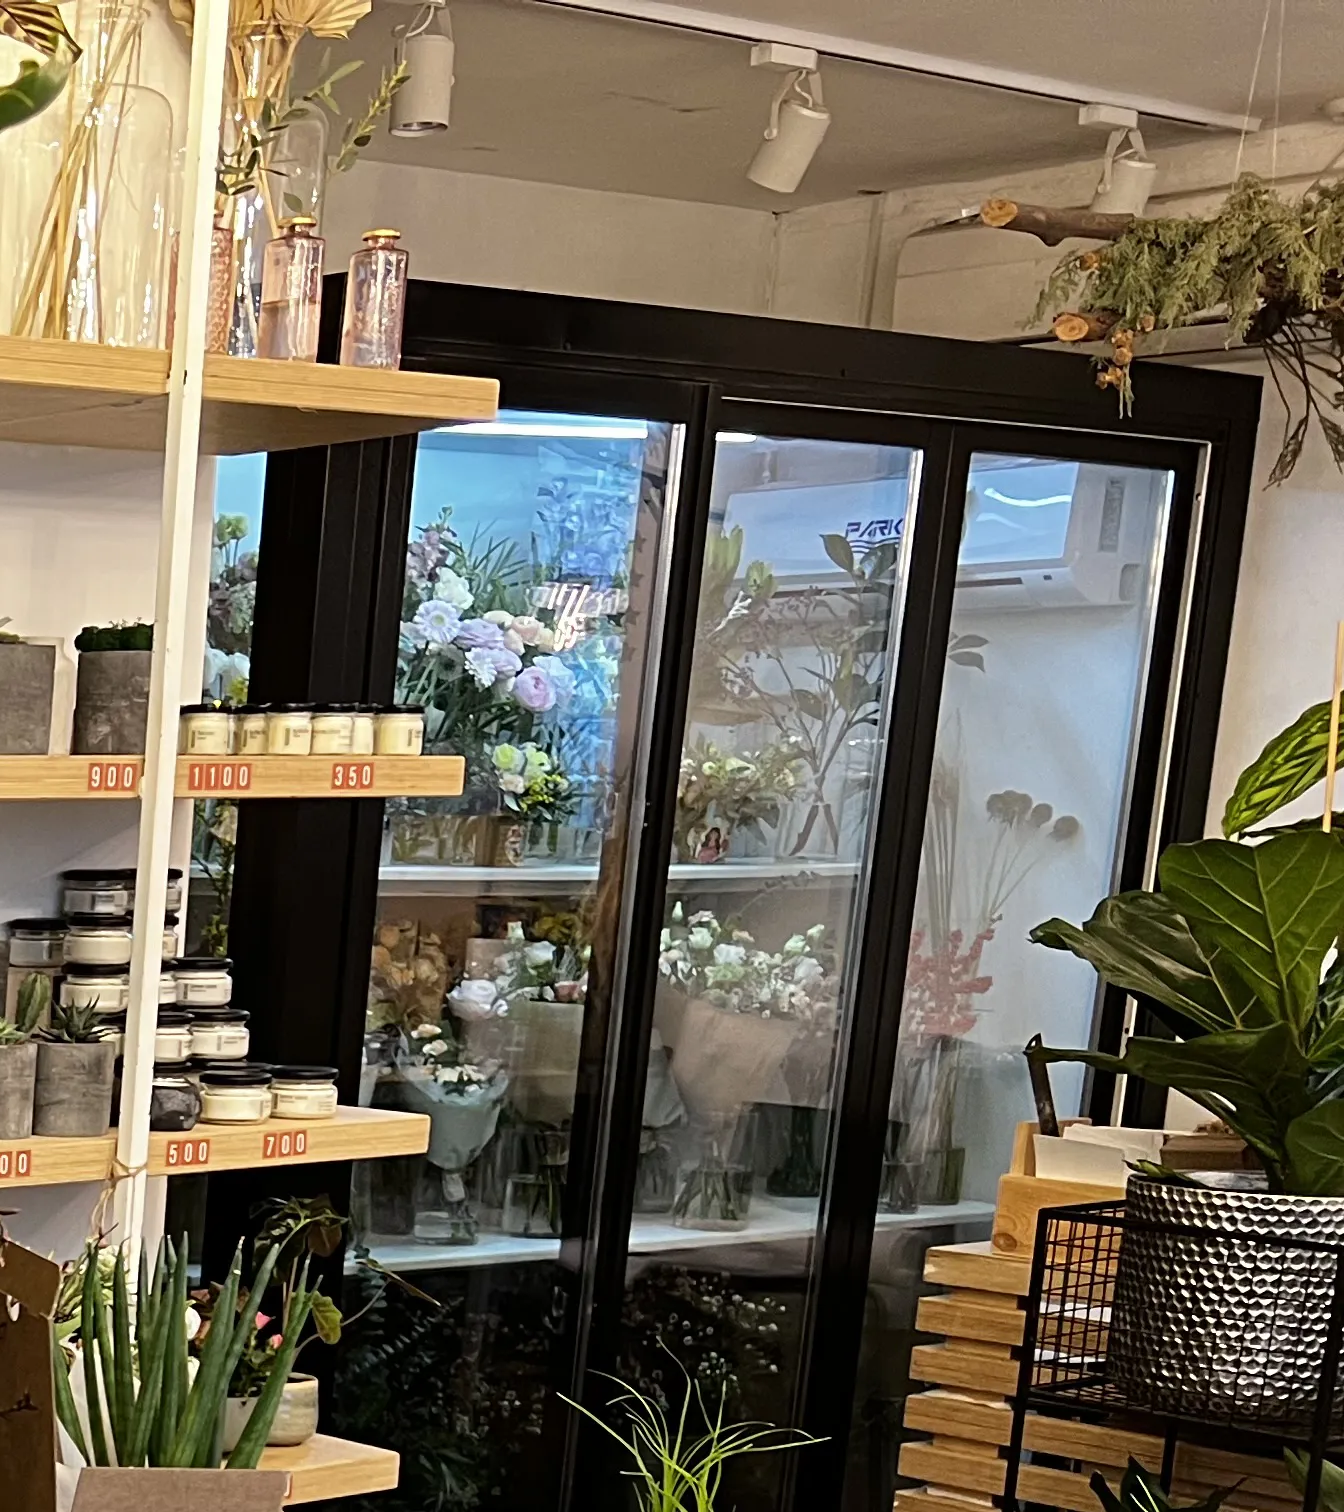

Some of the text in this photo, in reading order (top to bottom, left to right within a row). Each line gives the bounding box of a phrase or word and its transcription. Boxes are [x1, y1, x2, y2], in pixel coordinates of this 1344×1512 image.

[91, 766, 134, 788] 900
[192, 766, 249, 787] 1100
[334, 765, 371, 787] 350
[168, 1141, 208, 1164] 500
[266, 1133, 306, 1156] 700
